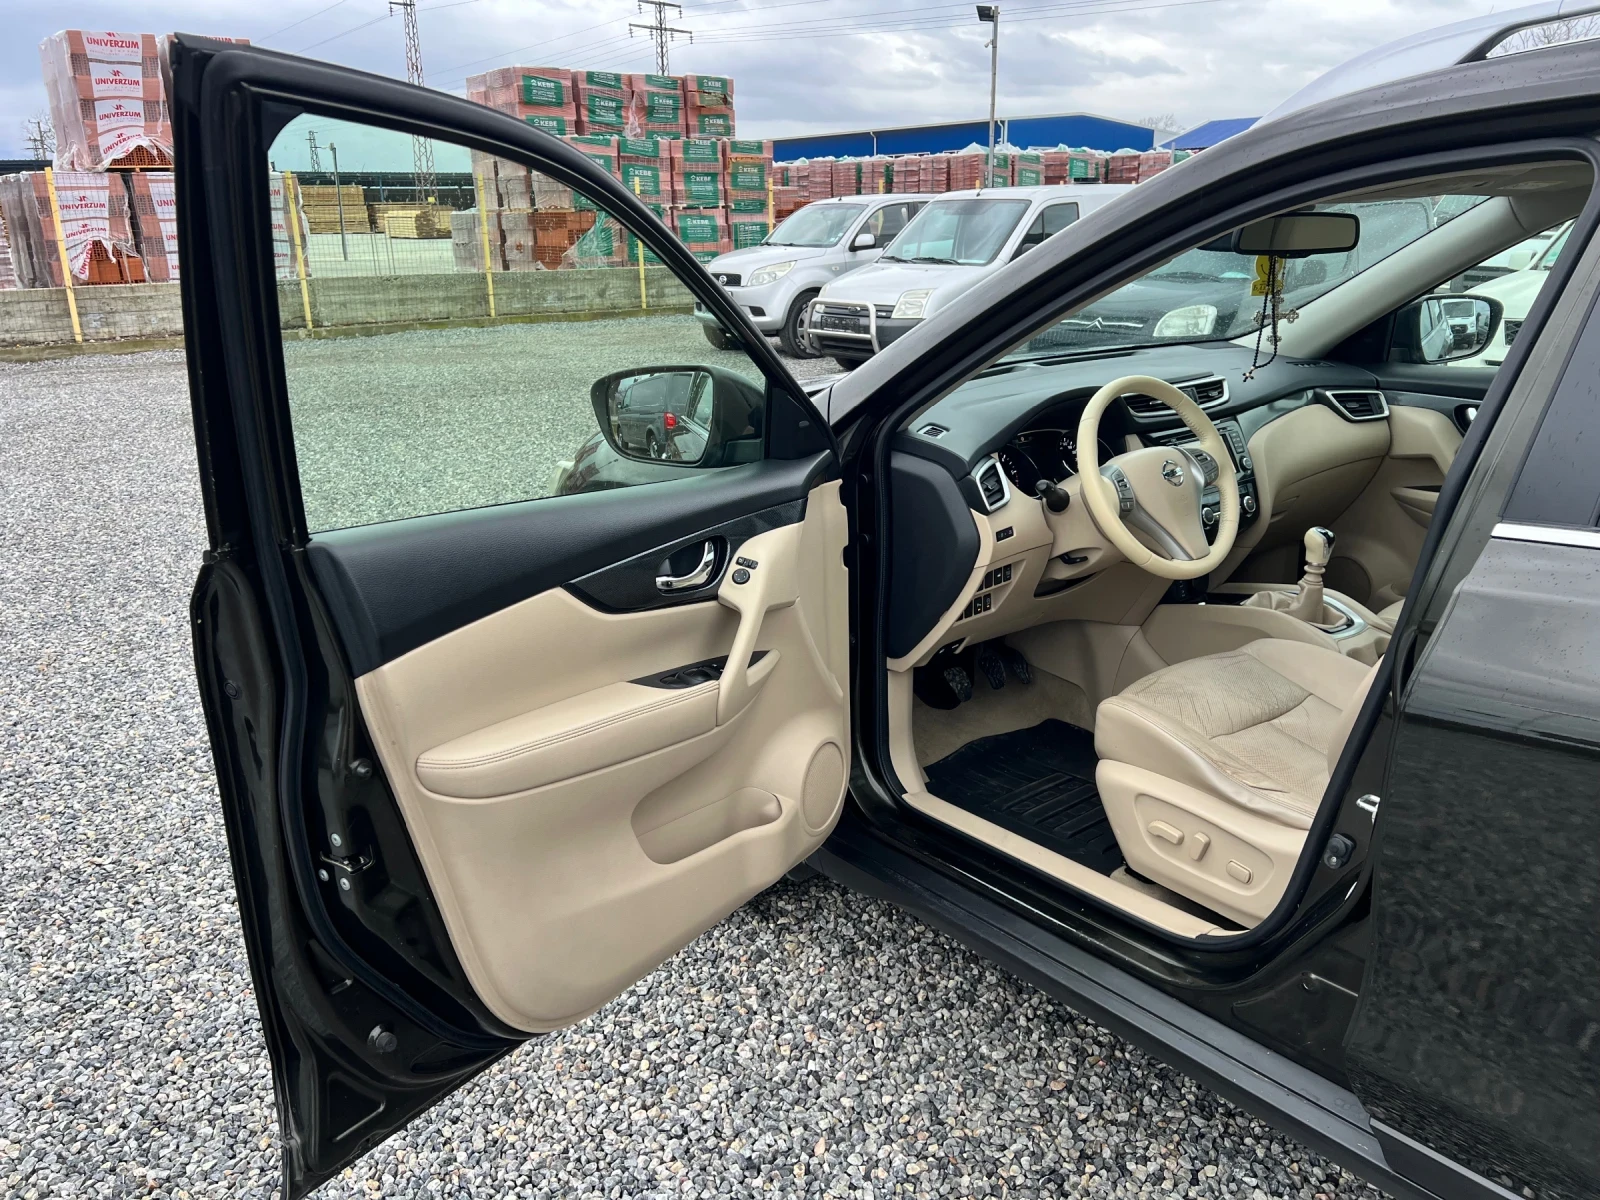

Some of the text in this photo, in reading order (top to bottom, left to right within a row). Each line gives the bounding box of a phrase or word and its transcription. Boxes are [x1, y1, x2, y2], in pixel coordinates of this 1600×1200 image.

[86, 36, 139, 50] UNIVERZUM
[95, 78, 140, 86] UNIVERZUM
[600, 100, 616, 108] KEBE
[99, 111, 142, 120] UNIVERZUM
[66, 227, 106, 239] UNIVERZUM
